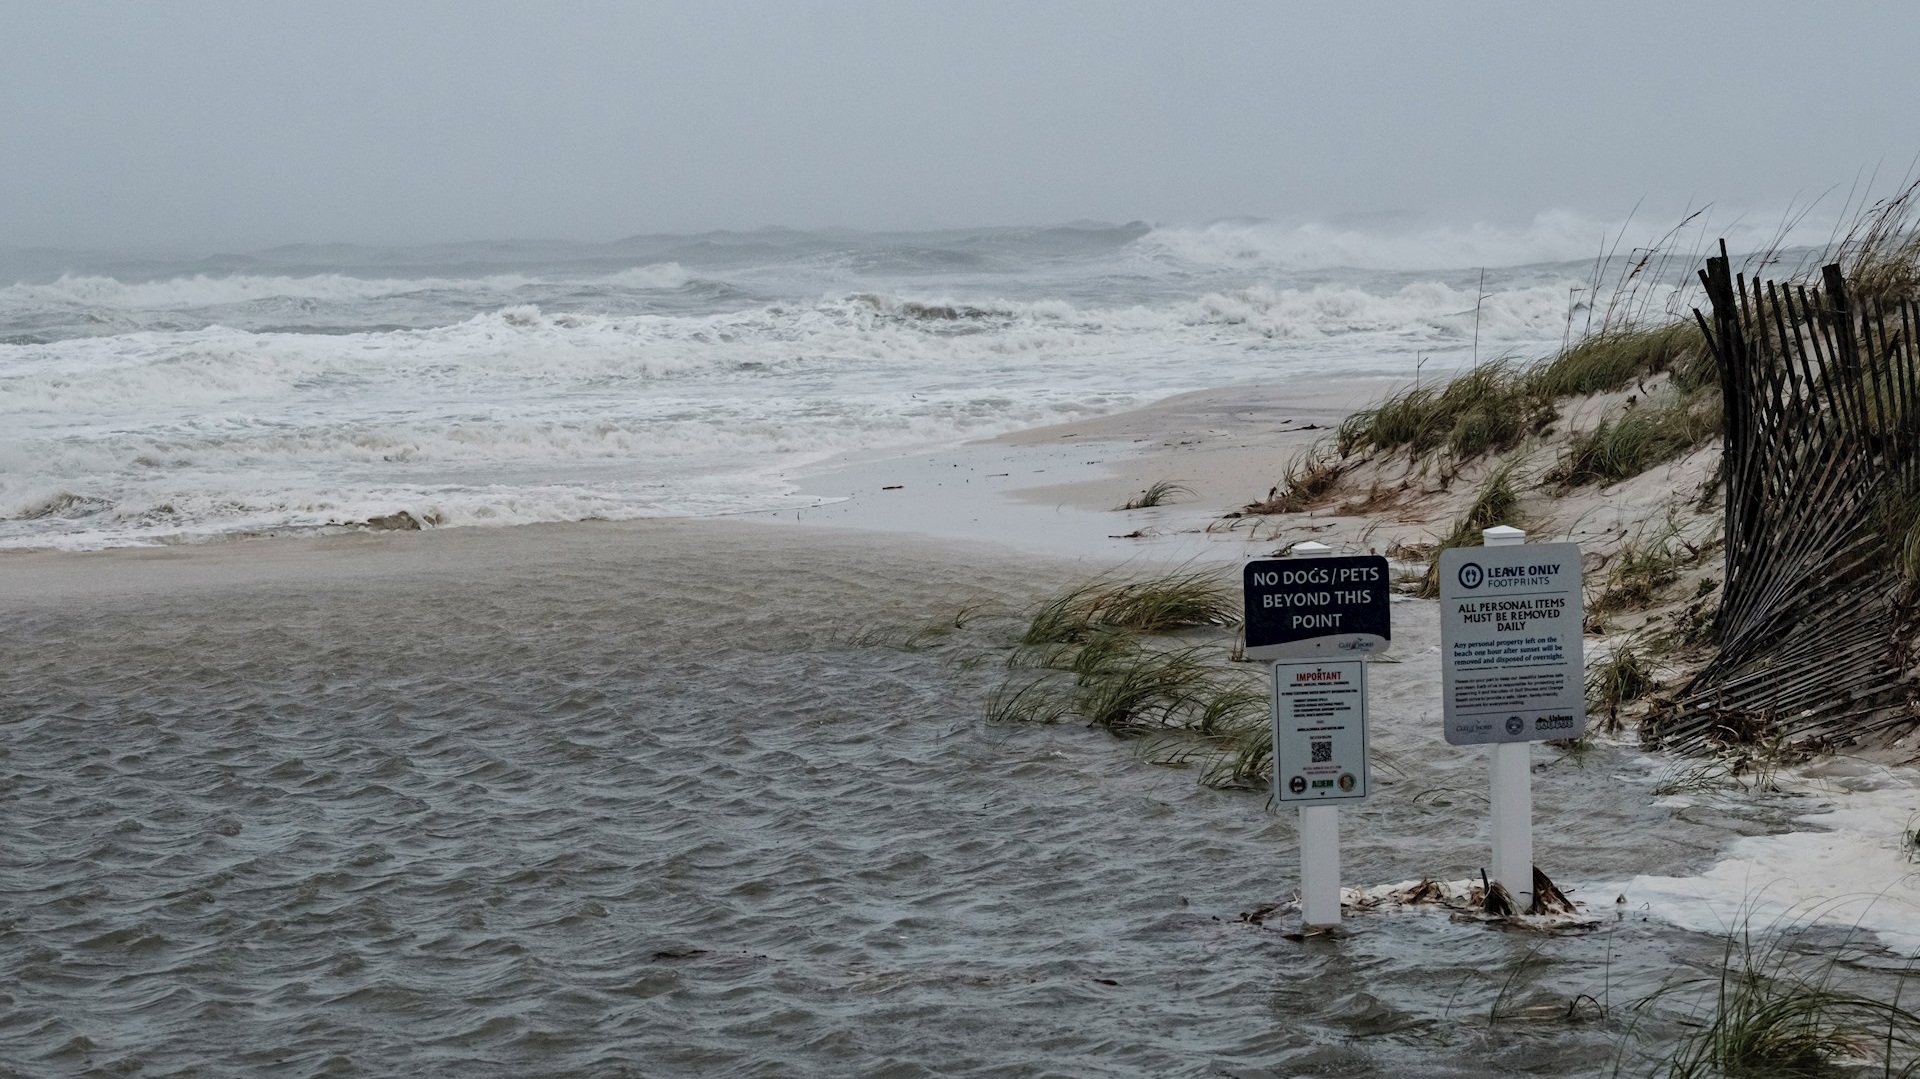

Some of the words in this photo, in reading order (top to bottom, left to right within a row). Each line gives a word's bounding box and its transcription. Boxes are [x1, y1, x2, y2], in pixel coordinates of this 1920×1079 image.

[1488, 566, 1525, 578] LEAVE
[1529, 564, 1560, 576] ONLY
[1254, 572, 1278, 586] NO
[1488, 577, 1550, 588] FOOTPRINTS
[1263, 592, 1330, 608] BEYOND
[1335, 590, 1371, 604] THIS
[1458, 603, 1476, 613] ALL
[1480, 600, 1532, 612] PERSONAL
[1536, 599, 1565, 609] ITEMS
[1292, 614, 1342, 629] POINT
[1464, 613, 1492, 623] MUST
[1496, 612, 1507, 621] BE
[1511, 609, 1560, 620] REMOVED
[1497, 622, 1526, 632] DAILY
[1496, 656, 1523, 664] disposed
[1296, 672, 1342, 681] IMPORTANT
